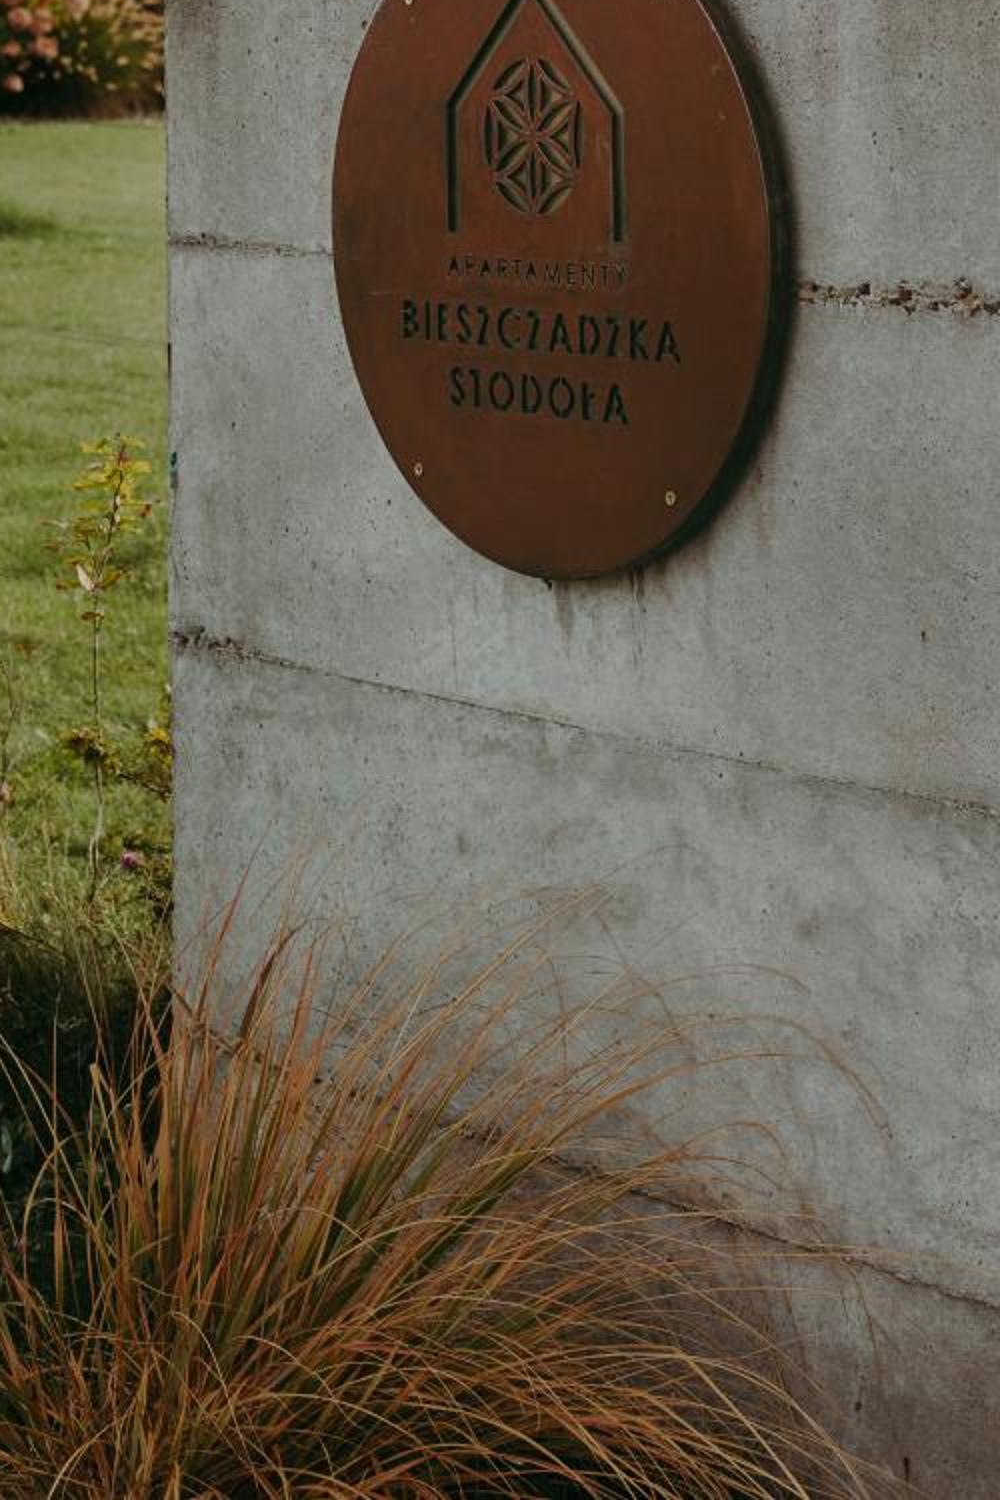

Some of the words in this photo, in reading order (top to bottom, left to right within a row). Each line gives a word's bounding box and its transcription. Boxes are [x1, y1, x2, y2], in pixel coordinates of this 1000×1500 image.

[447, 257, 628, 288] APARTAMENTY
[402, 300, 681, 364] BIESZCZADZKA
[450, 366, 628, 425] STODOŁA
